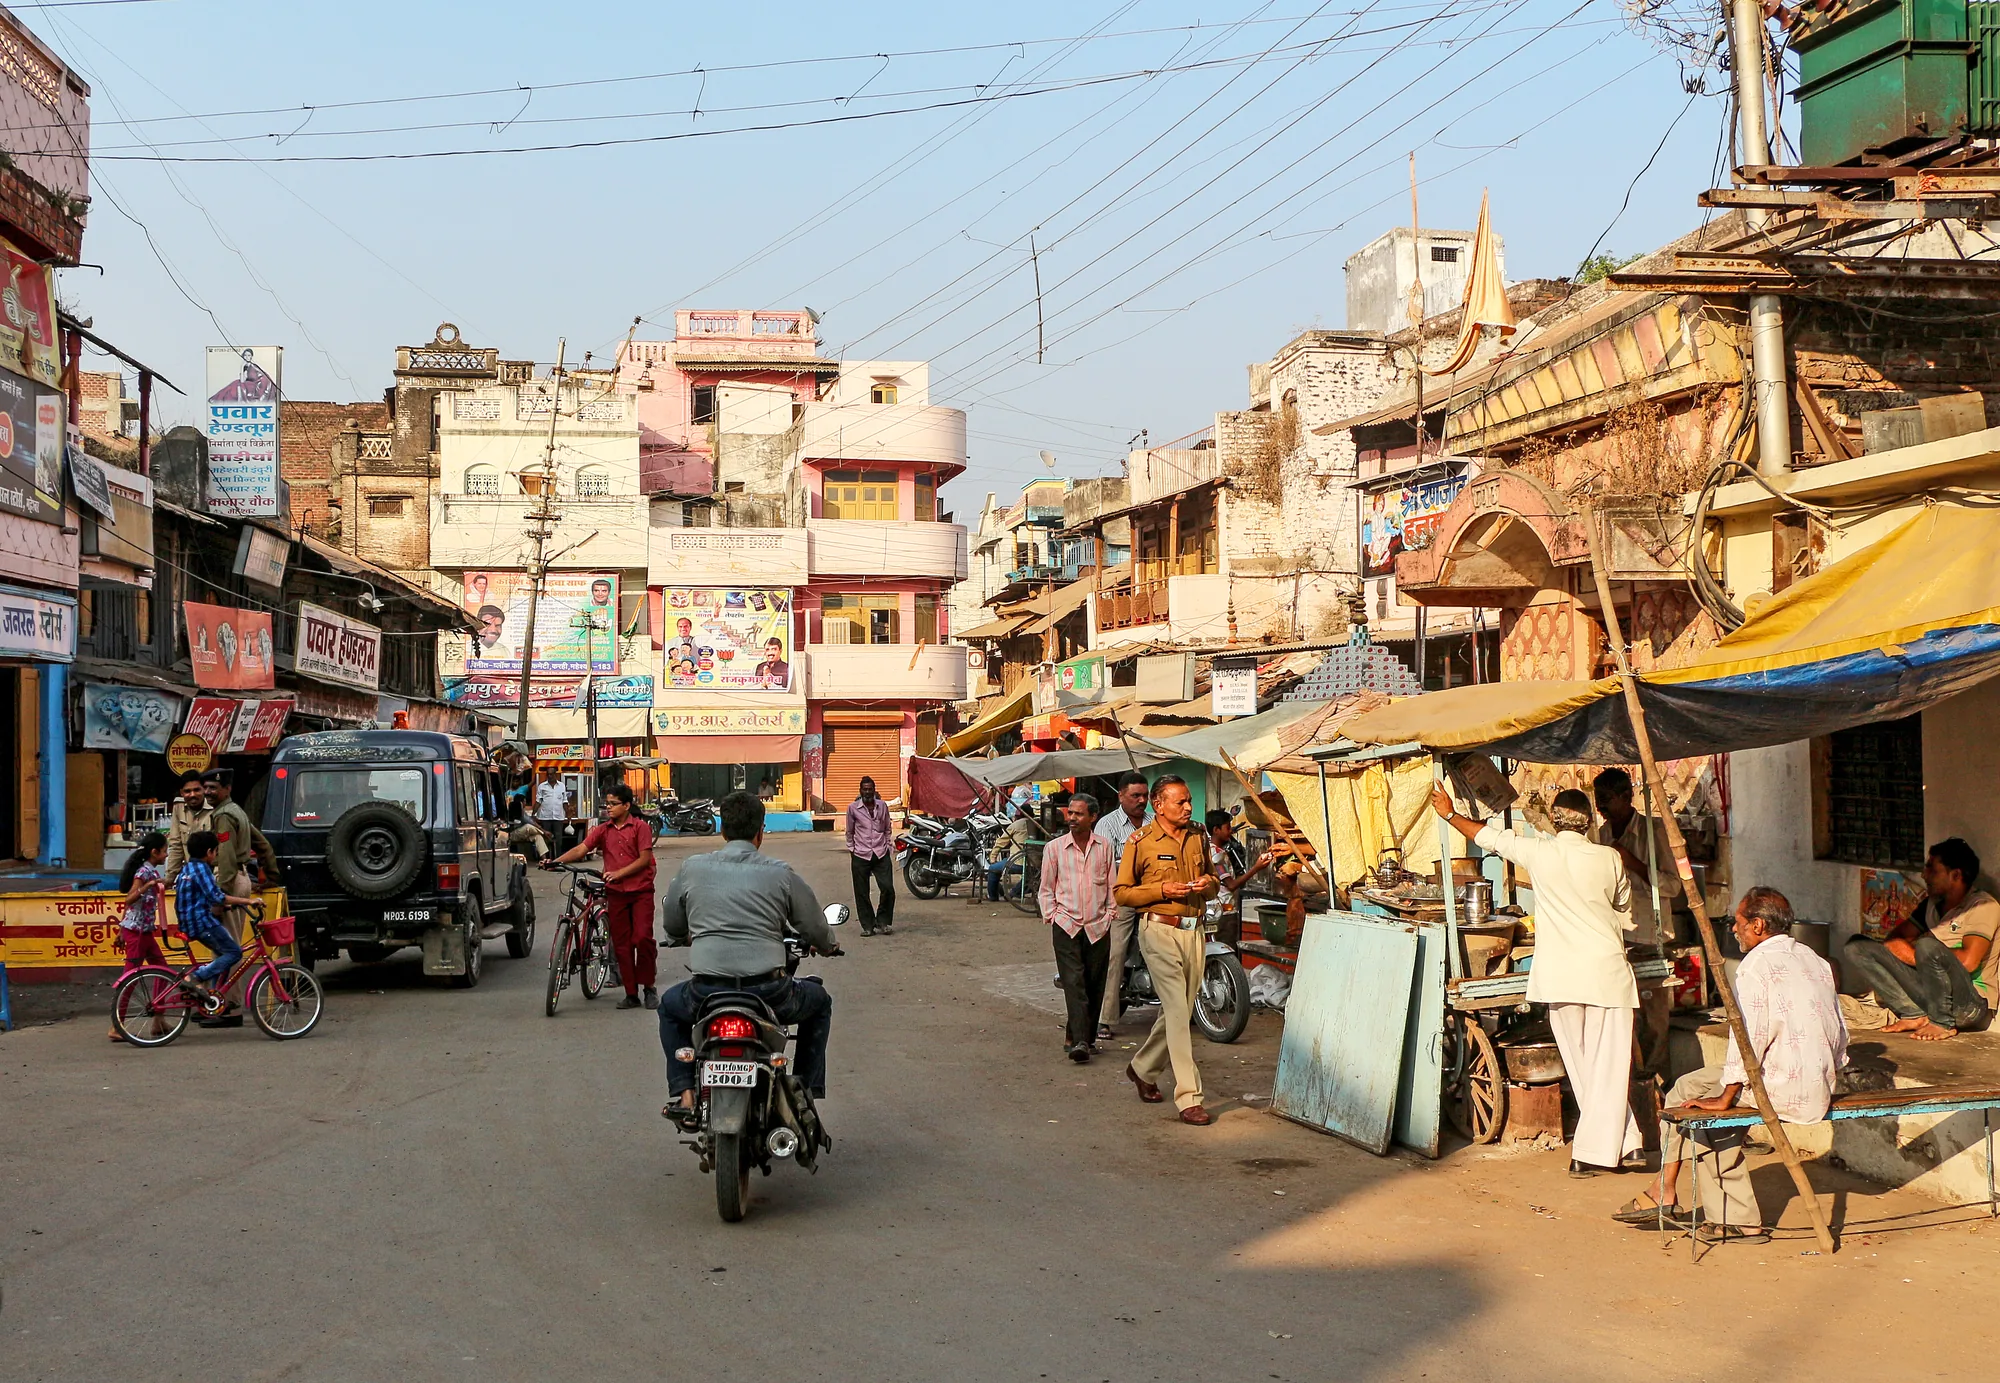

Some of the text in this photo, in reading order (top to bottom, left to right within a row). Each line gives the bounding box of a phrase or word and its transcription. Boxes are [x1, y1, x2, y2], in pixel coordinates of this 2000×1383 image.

[210, 406, 272, 419] पवार
[208, 419, 274, 437] हेण्डलूम
[208, 438, 275, 449] निर्माता एवं विक्रेता
[249, 494, 275, 507] चौक
[3, 606, 63, 642] जनरल स्टोर्स
[306, 616, 339, 659] पवार
[408, 910, 430, 920] 6198
[707, 1074, 753, 1085] 3004
